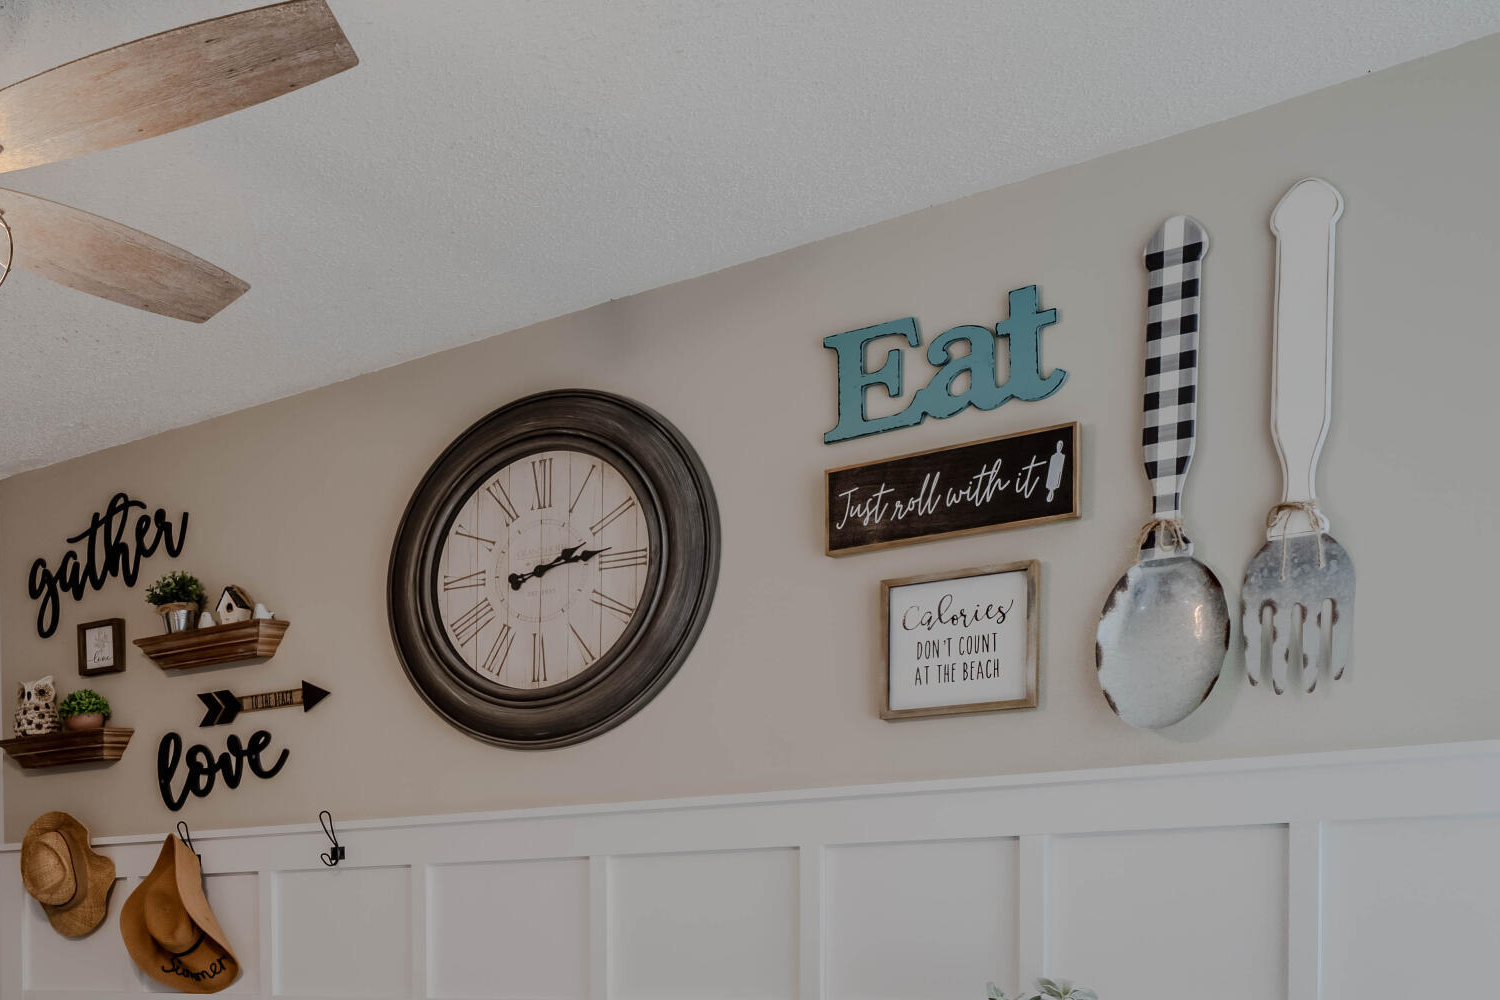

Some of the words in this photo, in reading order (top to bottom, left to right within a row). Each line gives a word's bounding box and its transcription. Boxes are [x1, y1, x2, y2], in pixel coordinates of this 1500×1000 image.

[823, 284, 1067, 444] Eat
[836, 483, 895, 530] Just
[891, 472, 941, 521] roll
[946, 458, 1010, 507] with
[1015, 455, 1047, 498] it
[28, 493, 189, 638] gather
[902, 594, 1014, 631] Calories
[915, 666, 930, 686] AT
[937, 663, 956, 684] THE
[963, 658, 1000, 681] BEACH
[916, 637, 952, 660] DON'T
[959, 632, 998, 656] COUNT
[157, 730, 290, 811] love
[161, 954, 228, 983] Summer
